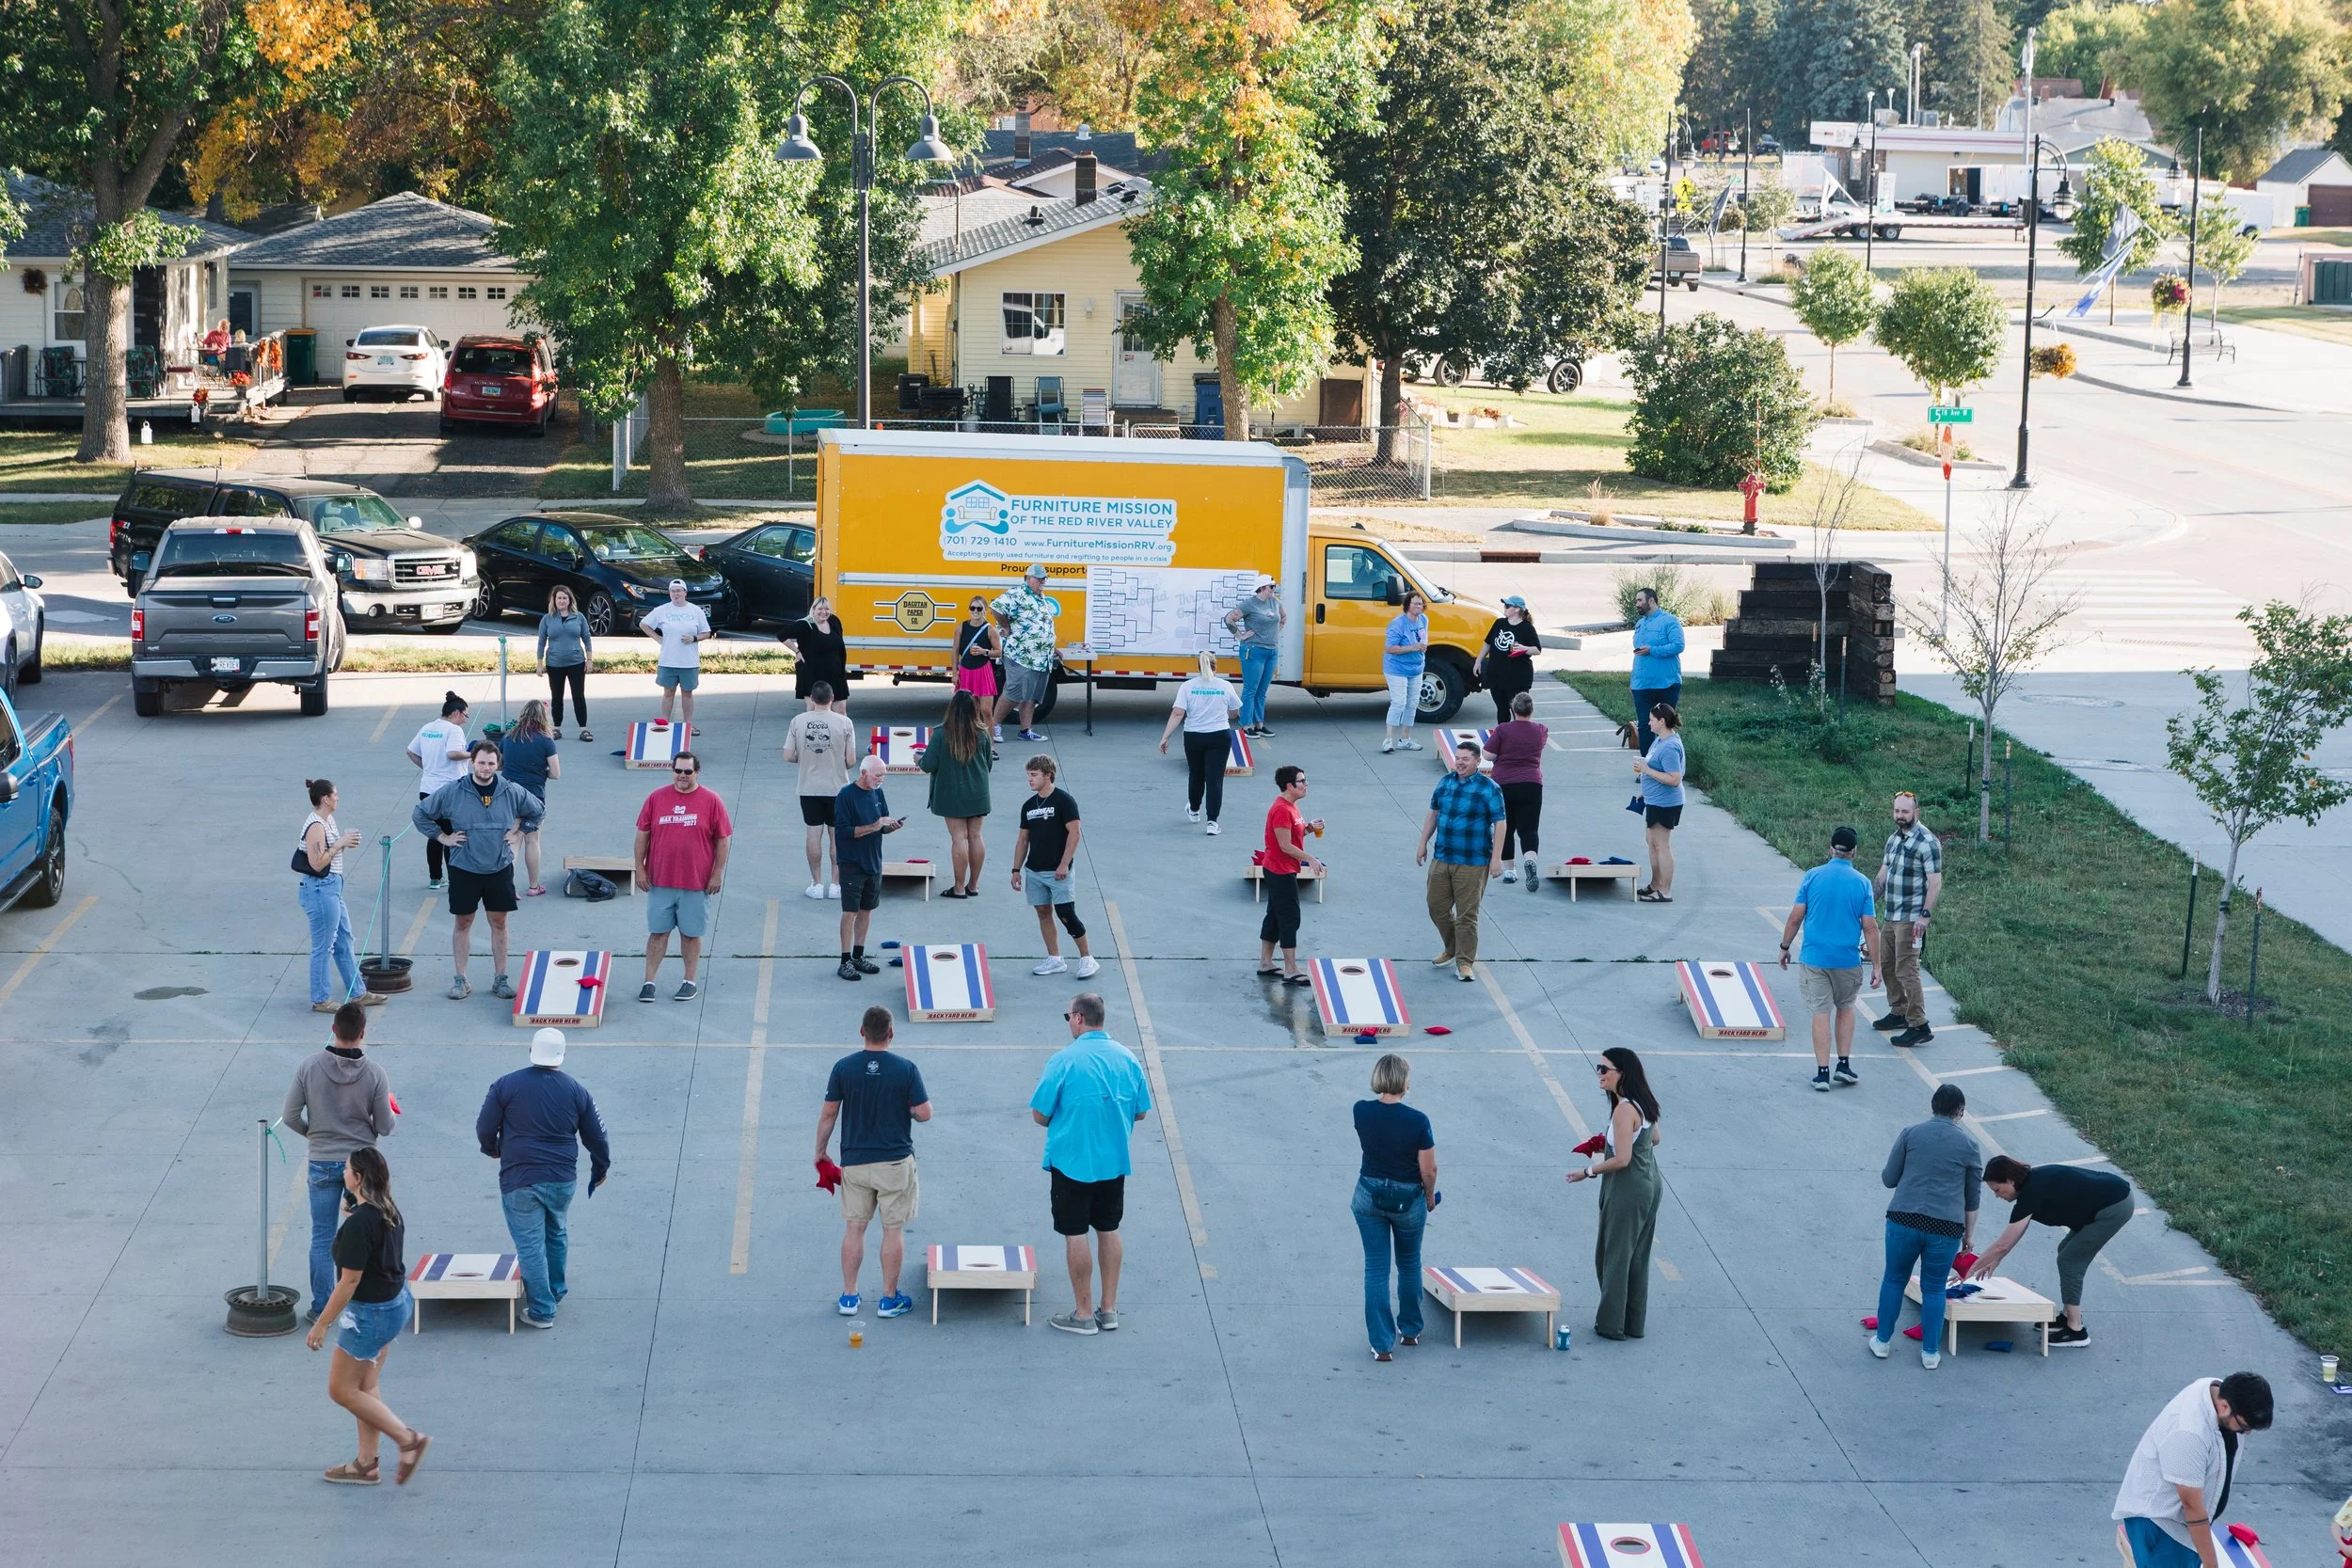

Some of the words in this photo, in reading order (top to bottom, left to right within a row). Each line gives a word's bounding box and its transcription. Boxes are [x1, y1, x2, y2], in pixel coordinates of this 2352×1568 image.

[1011, 499, 1101, 514] FURNITURE
[1107, 502, 1172, 515] MISSION
[1010, 515, 1026, 525] OF
[1031, 515, 1054, 526] THE
[1058, 517, 1082, 526] RED
[1087, 517, 1122, 527] RIVER
[1127, 518, 1172, 529] VALLEY
[944, 536, 967, 546] (701)
[971, 536, 1017, 546] 729-1410
[1025, 538, 1171, 552] www.FurnitureMissionRRV.org
[416, 565, 446, 576] GMC
[1045, 566, 1088, 576] support
[806, 721, 828, 730] Coors
